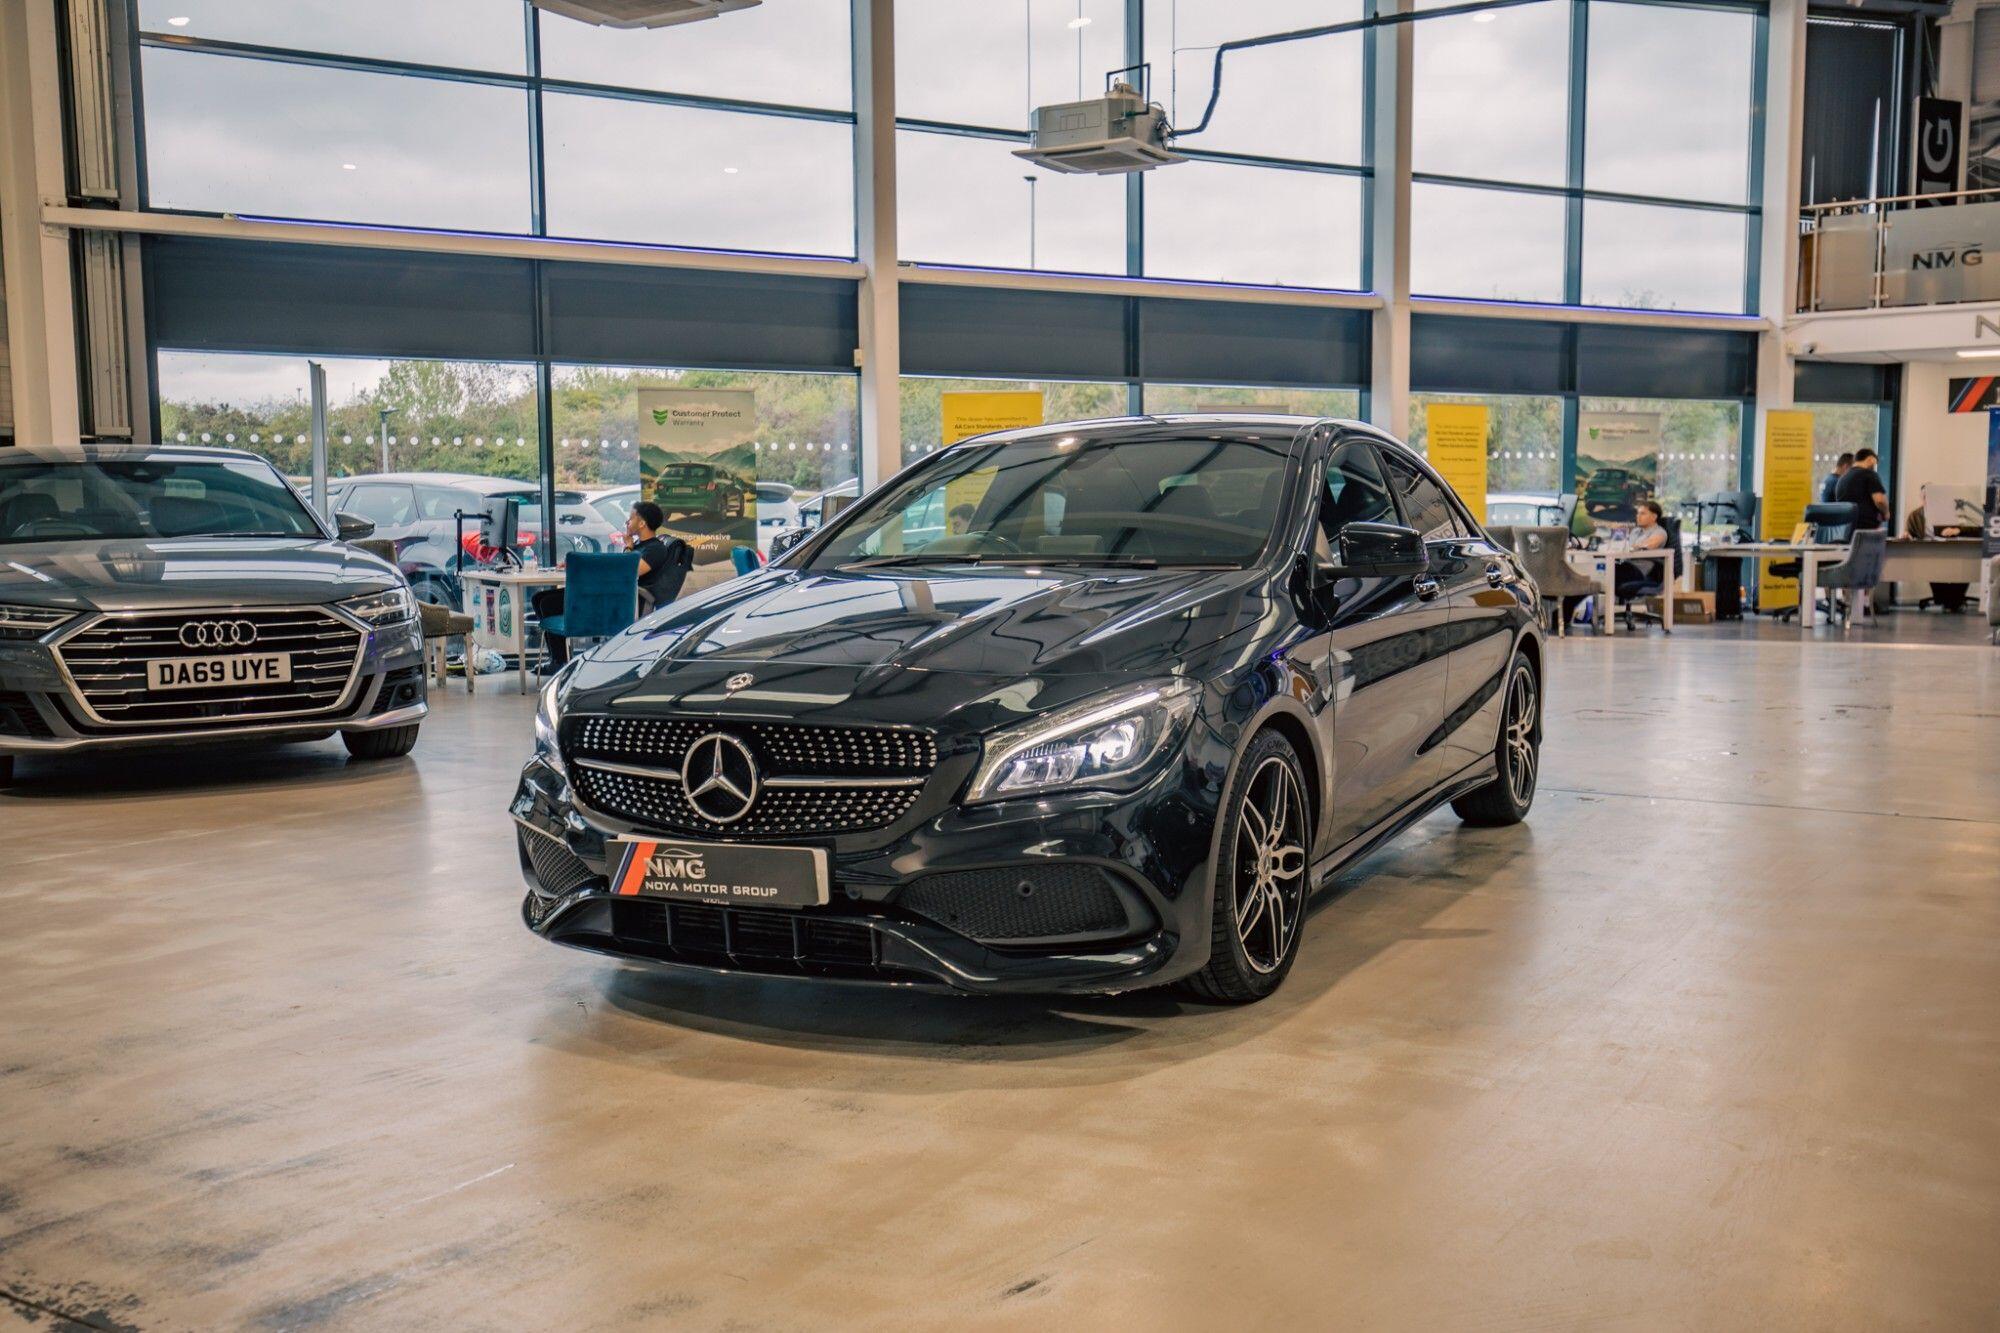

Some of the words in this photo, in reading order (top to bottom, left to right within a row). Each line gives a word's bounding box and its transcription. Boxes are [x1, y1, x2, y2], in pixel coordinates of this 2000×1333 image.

[1912, 249, 1983, 271] NMG
[712, 410, 741, 418] Protect
[159, 661, 225, 685] DA69
[231, 657, 281, 681] UYE
[643, 857, 706, 880] NMG
[645, 881, 679, 892] NOYA
[682, 883, 728, 895] MOTOR
[732, 885, 779, 898] GROUP
